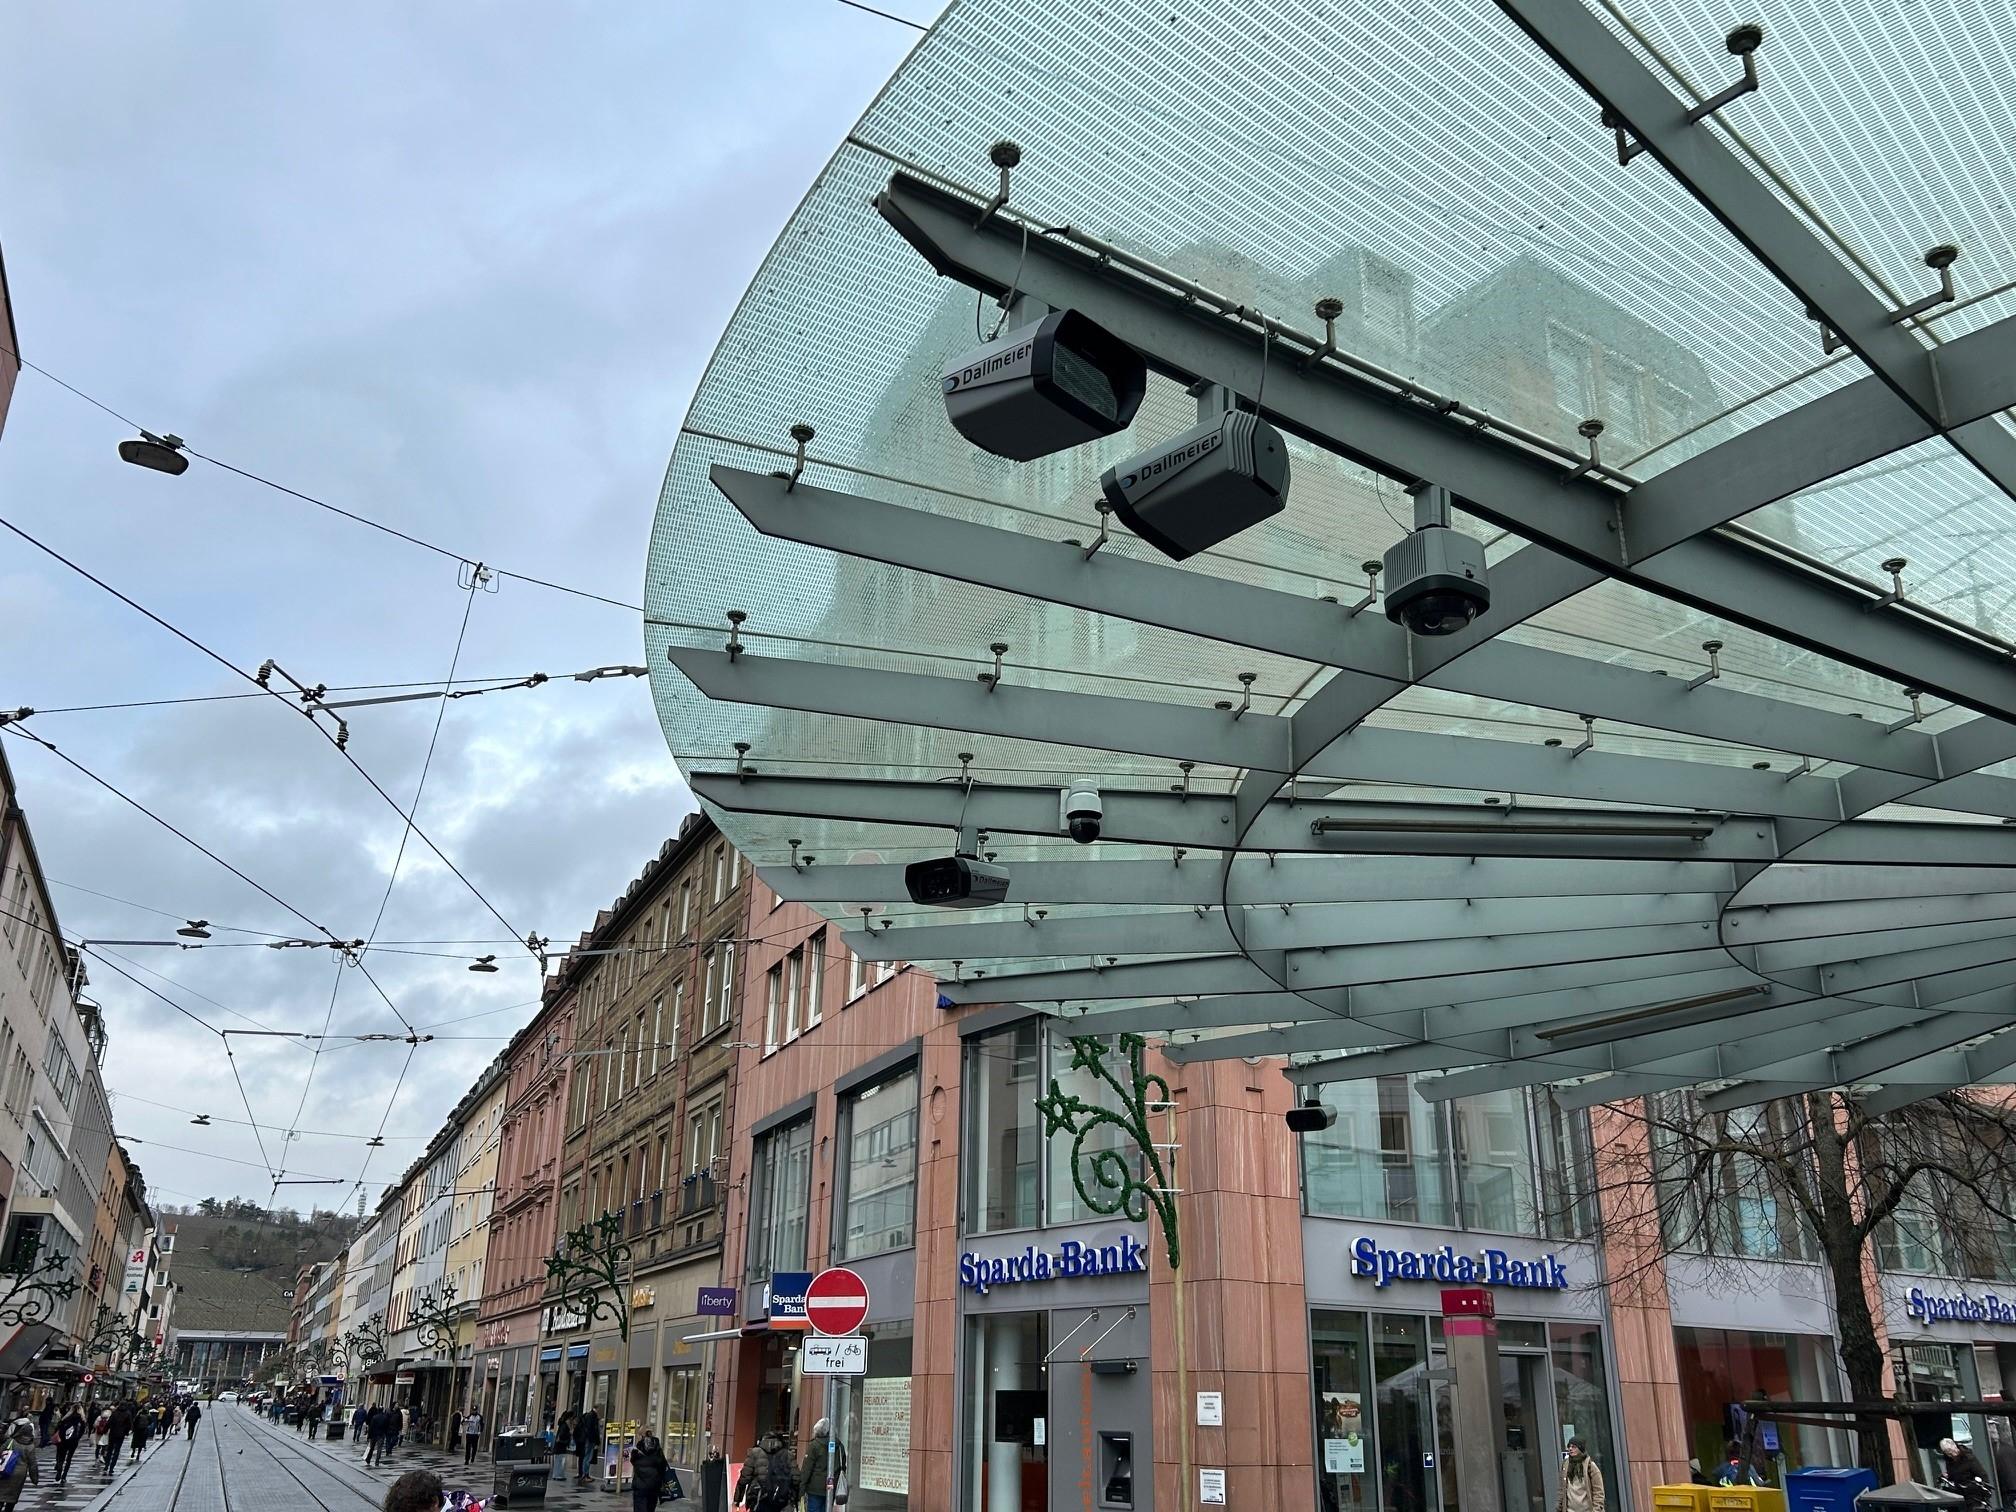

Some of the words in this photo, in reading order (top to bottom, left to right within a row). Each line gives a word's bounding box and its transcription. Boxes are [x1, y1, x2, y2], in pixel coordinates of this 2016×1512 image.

[962, 343, 1032, 385] Dallmeier
[1141, 434, 1218, 480] Dallmeier
[959, 1235, 1147, 1294] Sparda-Bank
[1350, 1237, 1568, 1287] Sparda-Bank
[701, 1294, 733, 1308] liberty
[783, 1304, 806, 1314] Ban
[825, 1356, 845, 1368] frei
